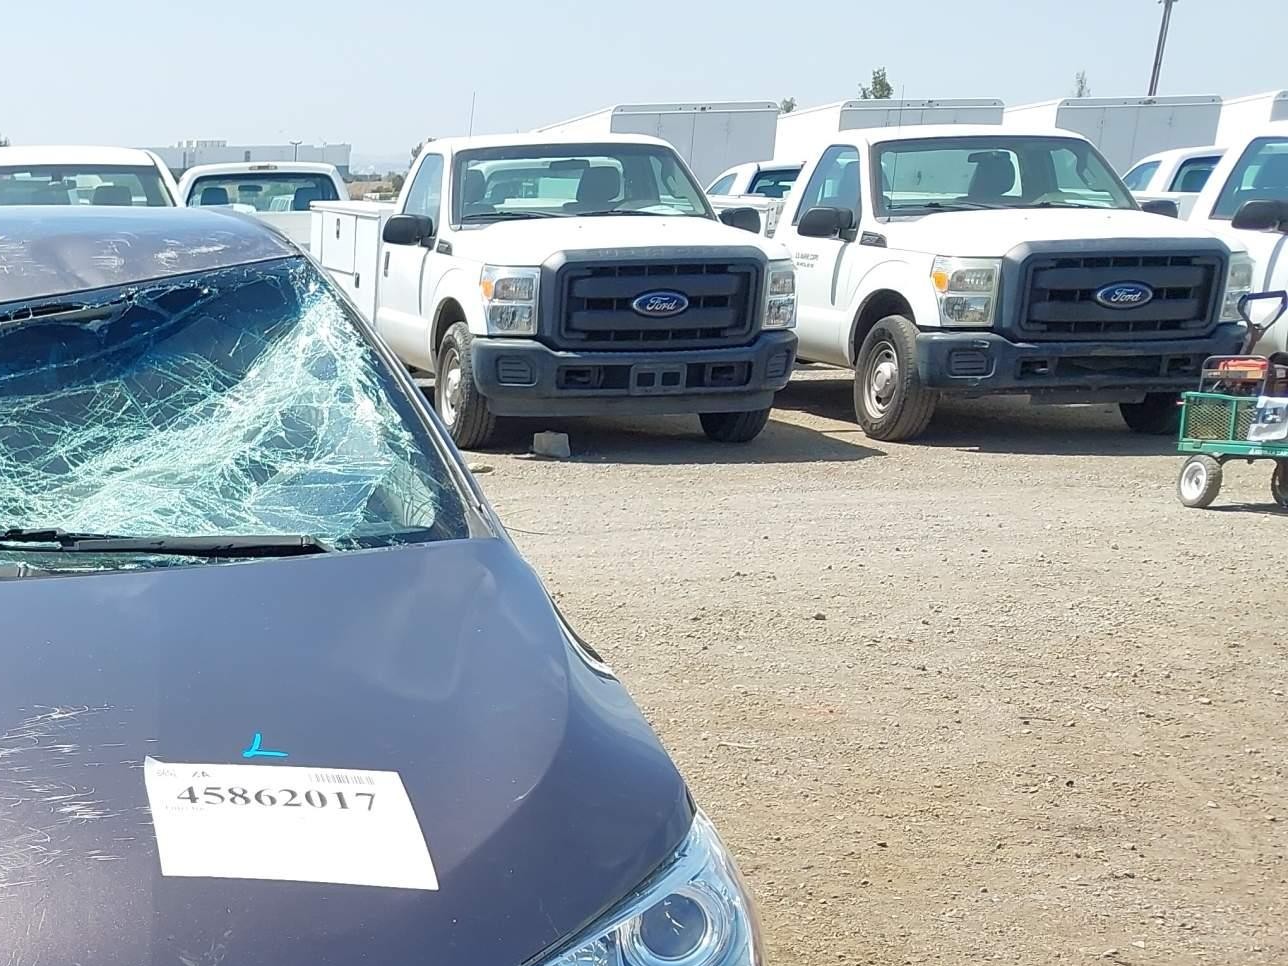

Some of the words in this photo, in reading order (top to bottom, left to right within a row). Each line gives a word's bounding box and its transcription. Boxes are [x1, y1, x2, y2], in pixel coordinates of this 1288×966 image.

[1110, 288, 1142, 302] Ford
[646, 296, 677, 311] Ford
[176, 784, 377, 812] 45862017
